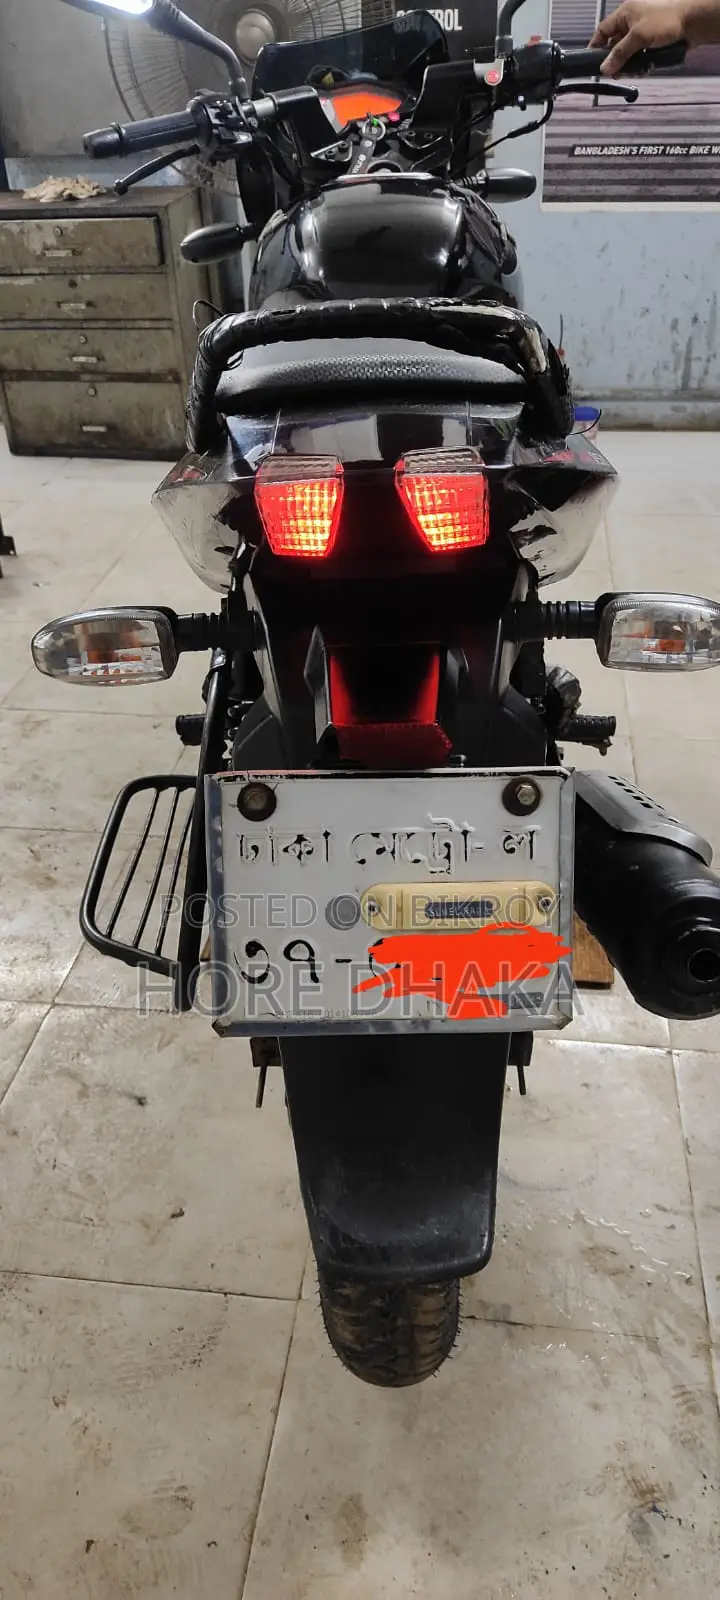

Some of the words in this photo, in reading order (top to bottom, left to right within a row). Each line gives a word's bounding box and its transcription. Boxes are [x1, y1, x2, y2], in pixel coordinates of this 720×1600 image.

[574, 146, 638, 155] BANGLADESH'S
[639, 146, 665, 155] FIRST
[689, 146, 711, 154] BIKE
[236, 826, 334, 865] ঢাকা
